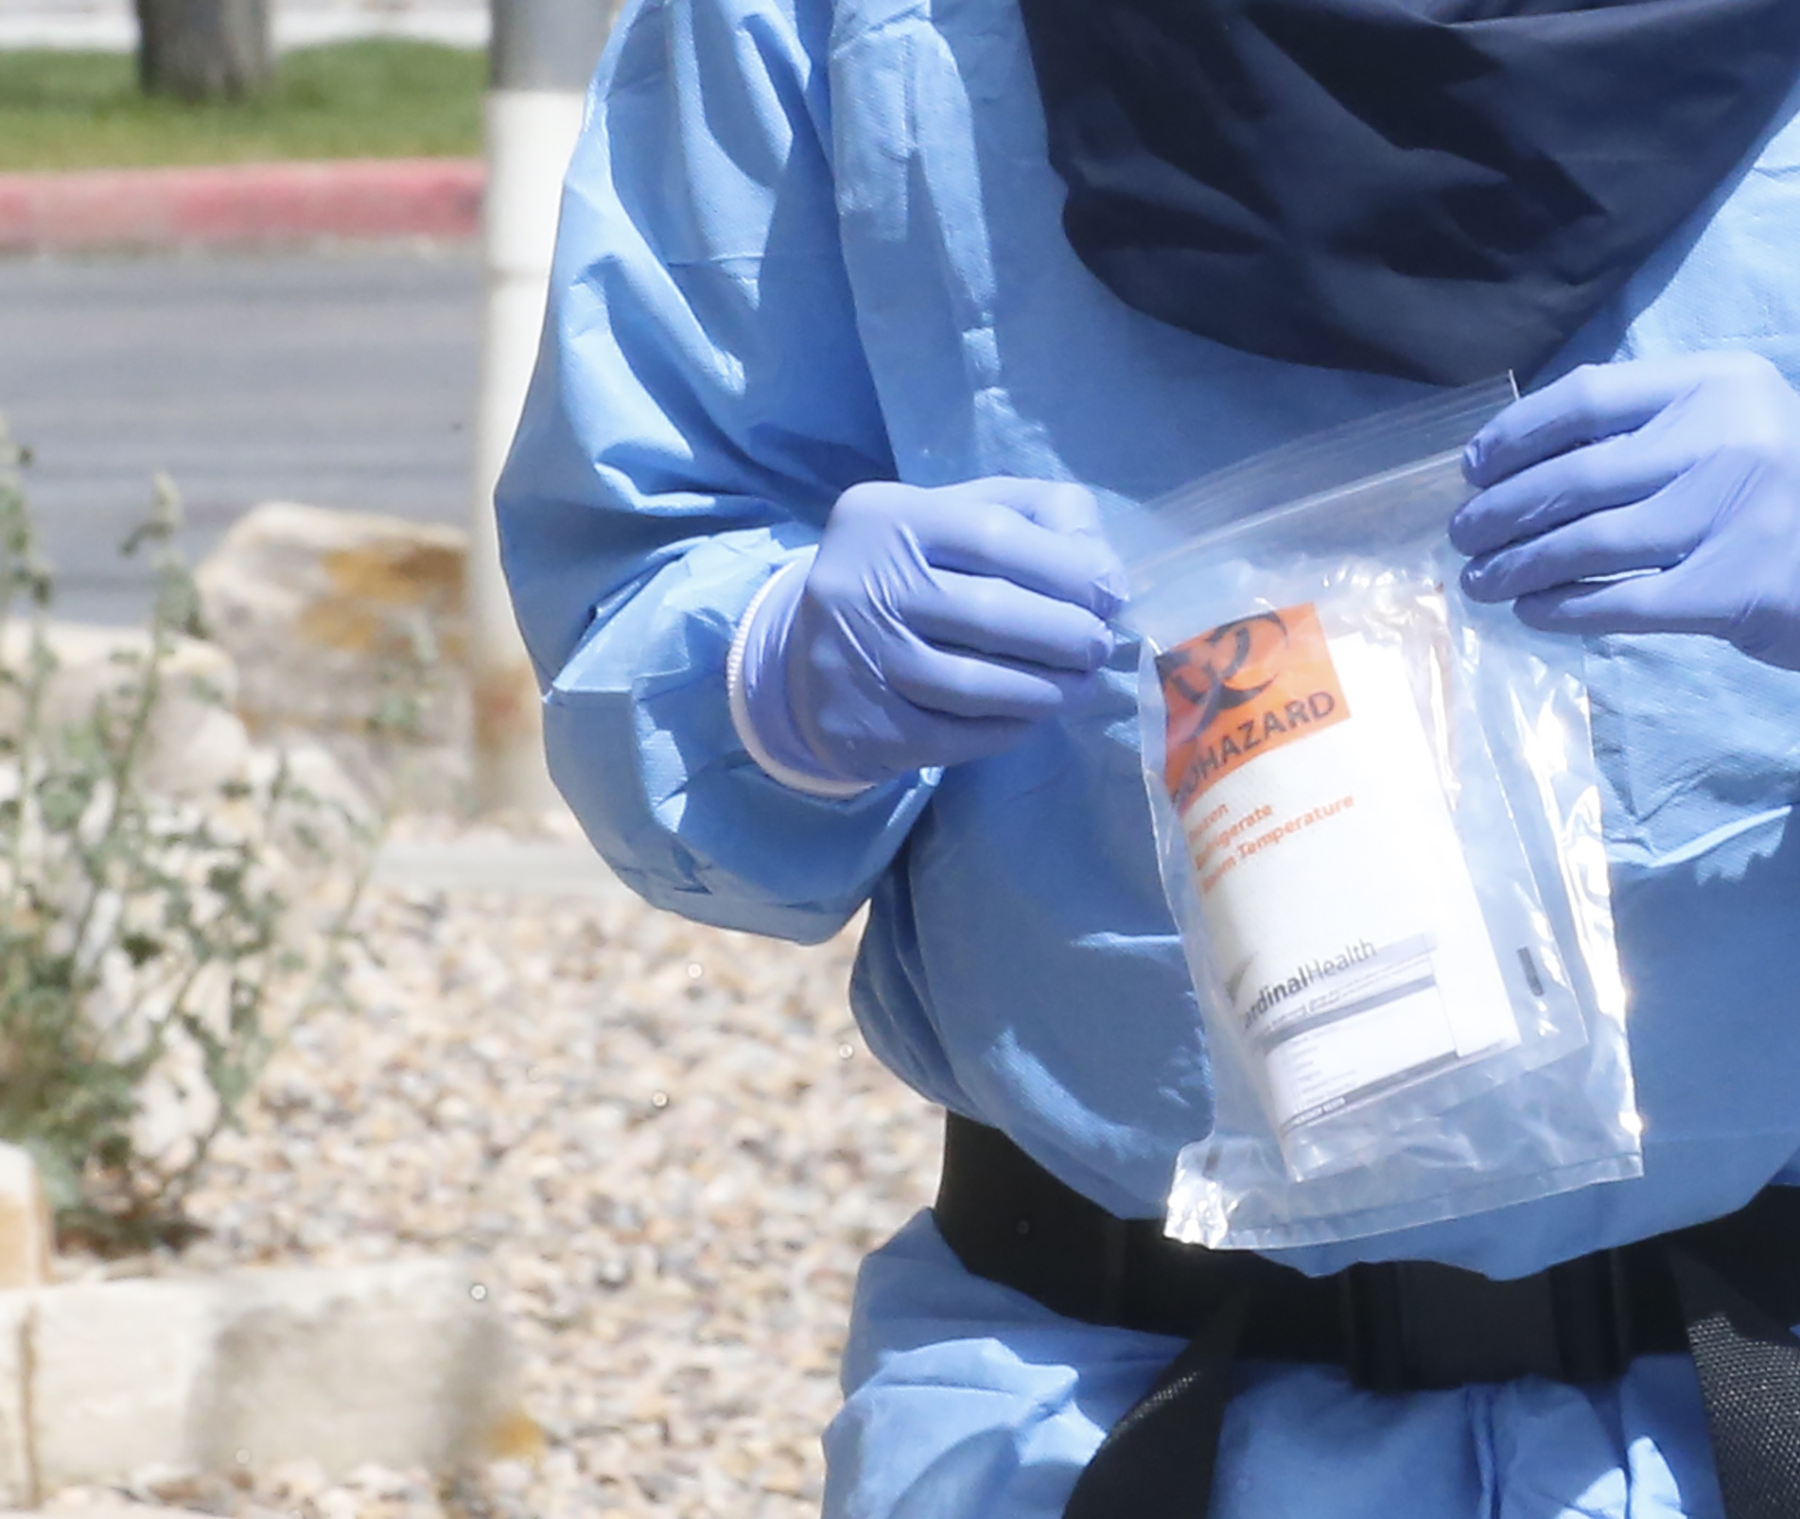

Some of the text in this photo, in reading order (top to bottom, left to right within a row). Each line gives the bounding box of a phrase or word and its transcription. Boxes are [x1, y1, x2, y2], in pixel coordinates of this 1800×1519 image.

[1195, 804, 1274, 871] igerate
[1237, 795, 1354, 858] Temperature
[1242, 937, 1377, 1030] ardinalHealth
